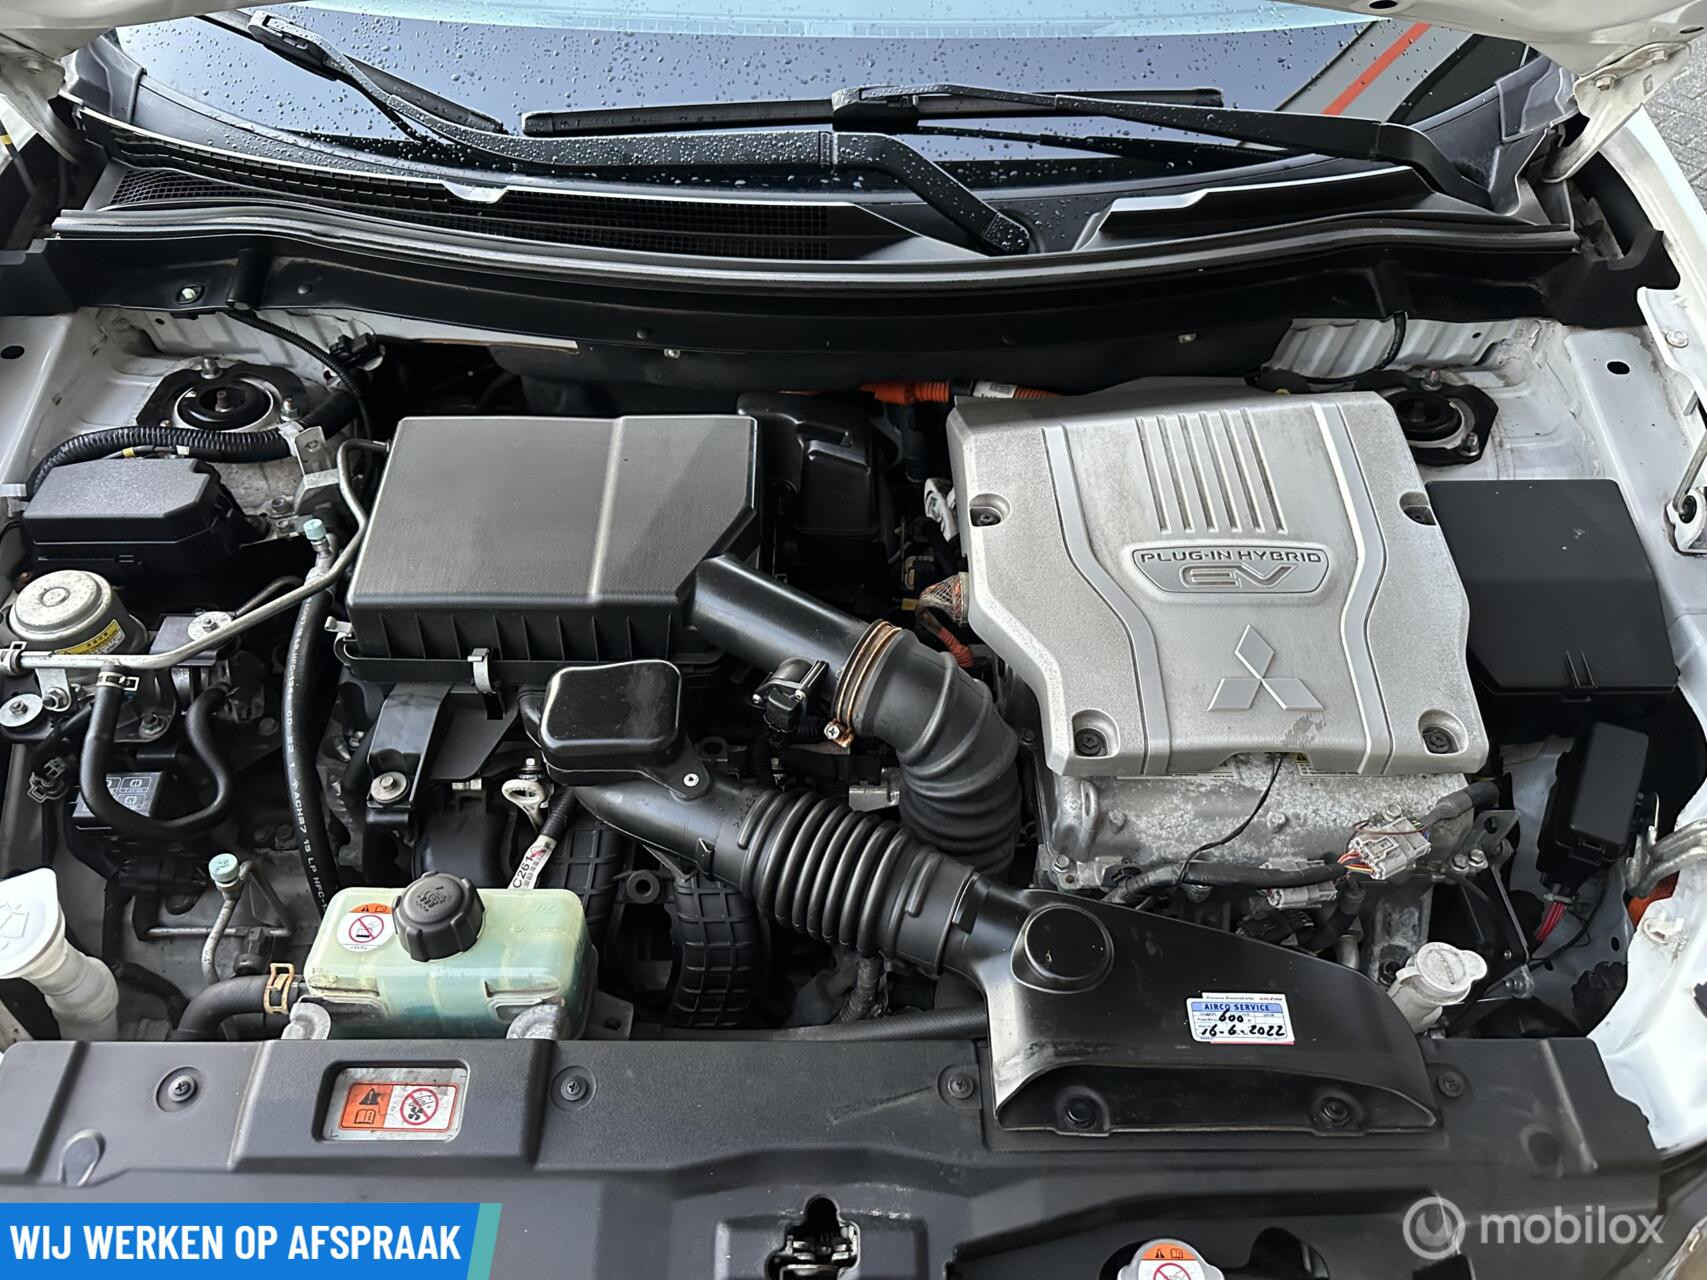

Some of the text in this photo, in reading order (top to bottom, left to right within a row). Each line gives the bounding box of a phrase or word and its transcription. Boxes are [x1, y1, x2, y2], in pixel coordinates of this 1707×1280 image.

[1140, 550, 1322, 563] PLUG-IN HYBRID
[303, 838, 312, 853] 15
[307, 857, 318, 873] LP
[1204, 1003, 1231, 1011] AIRCO
